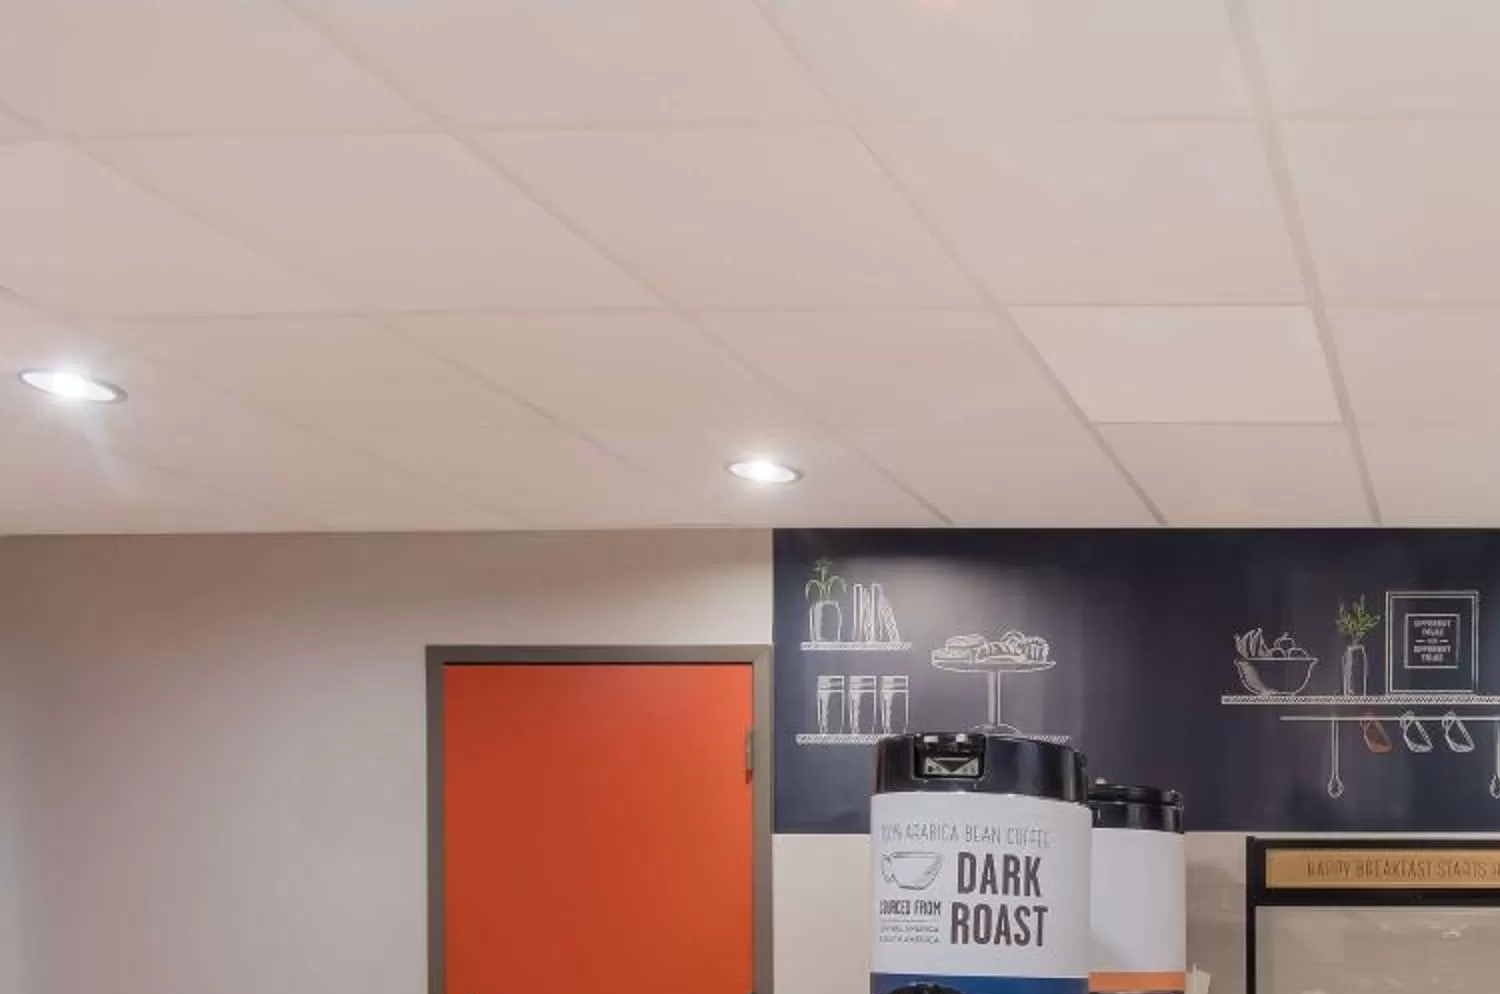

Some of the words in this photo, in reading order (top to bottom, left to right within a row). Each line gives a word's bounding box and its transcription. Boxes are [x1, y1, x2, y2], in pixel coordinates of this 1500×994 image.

[965, 824, 1001, 845] BEAN
[957, 851, 1042, 897] DARK
[1306, 857, 1350, 878] HAPPY
[1356, 856, 1432, 878] BREAKFAST
[1437, 858, 1487, 879] STARTS
[913, 899, 942, 916] FROM
[950, 901, 1049, 947] ROAST
